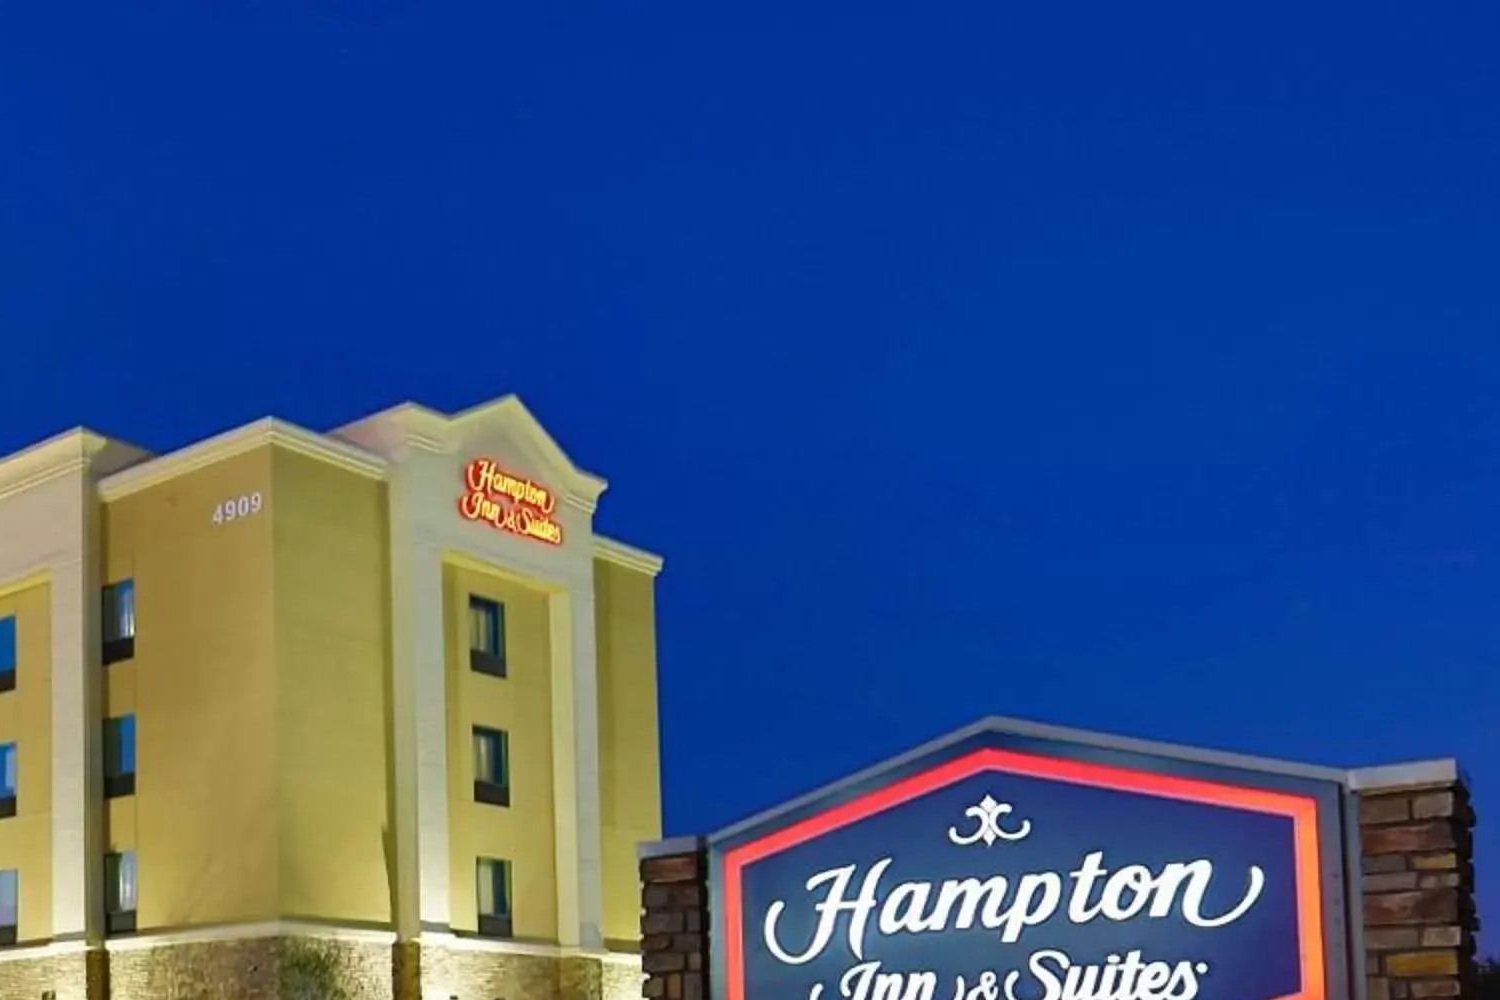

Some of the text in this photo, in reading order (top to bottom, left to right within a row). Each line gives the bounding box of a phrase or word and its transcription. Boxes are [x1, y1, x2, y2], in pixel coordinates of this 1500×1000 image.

[212, 491, 262, 525] 4909
[467, 459, 555, 514] Hampton
[462, 492, 562, 544] Inn & Suites
[764, 851, 1265, 964] Hampton
